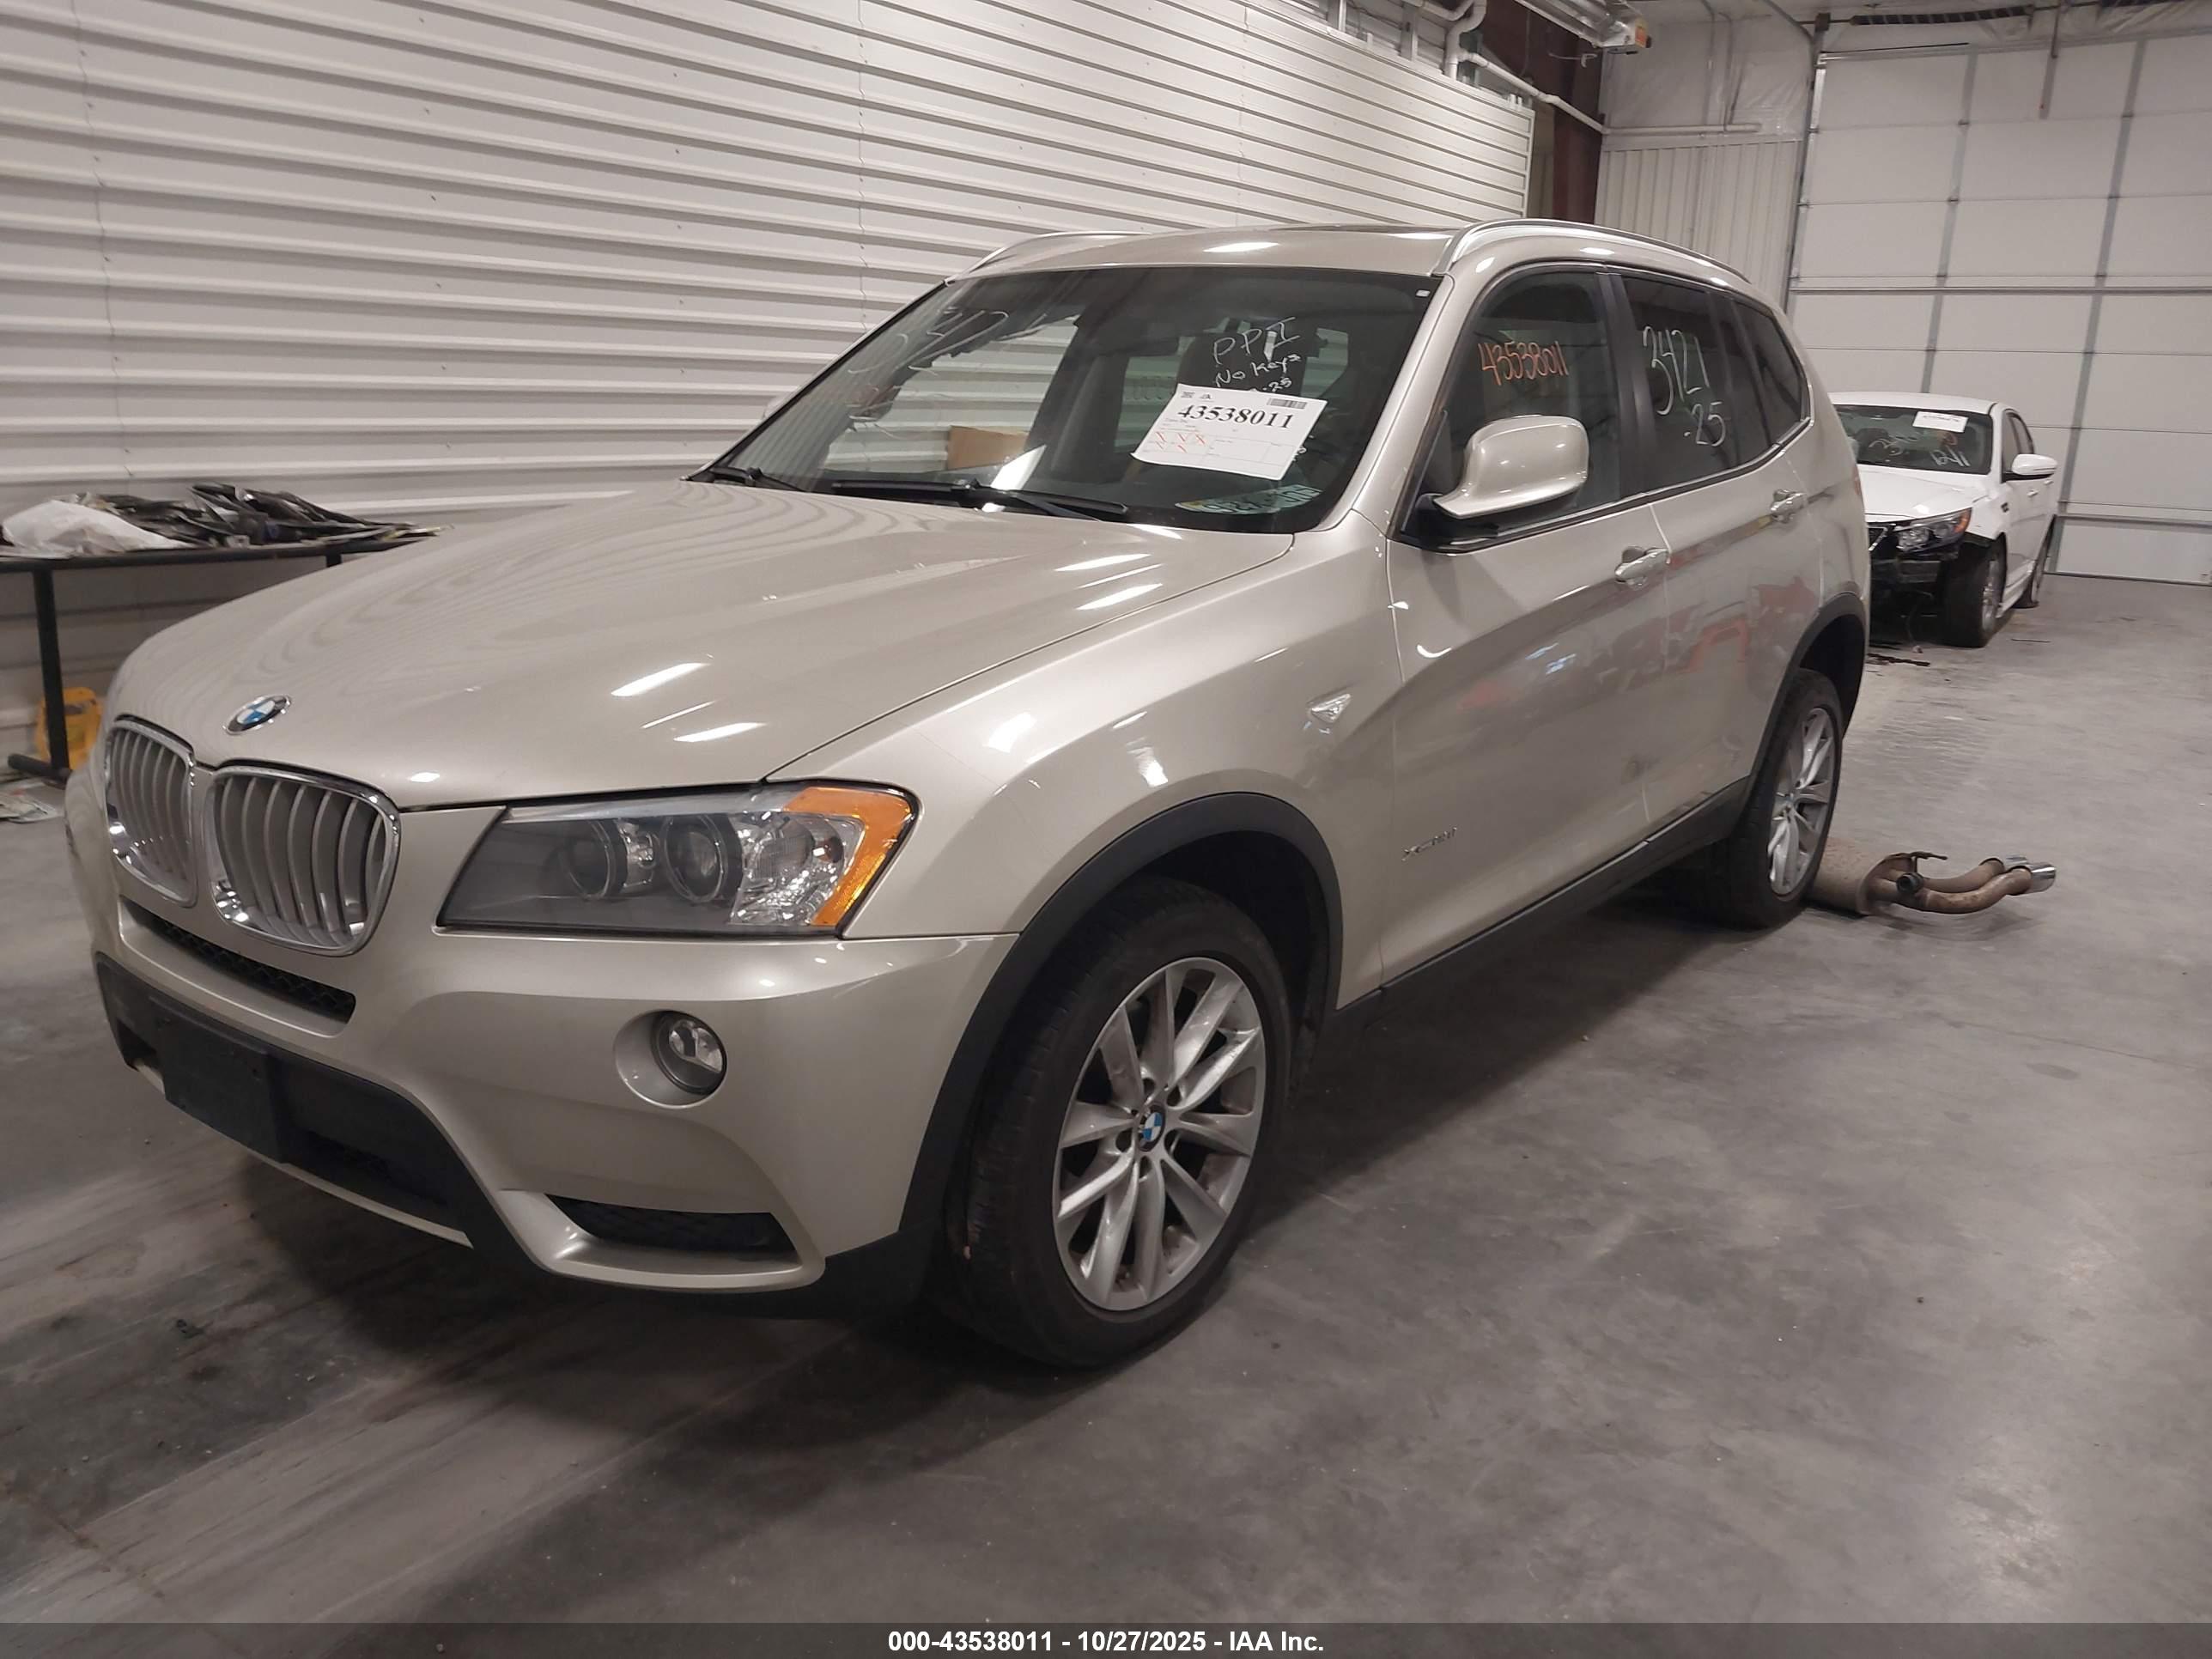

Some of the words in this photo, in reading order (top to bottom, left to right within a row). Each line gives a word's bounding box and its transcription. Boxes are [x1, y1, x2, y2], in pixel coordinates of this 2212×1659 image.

[1212, 316, 1301, 366] PPI
[1477, 340, 1569, 386] 43538011
[1177, 404, 1294, 429] 43538011
